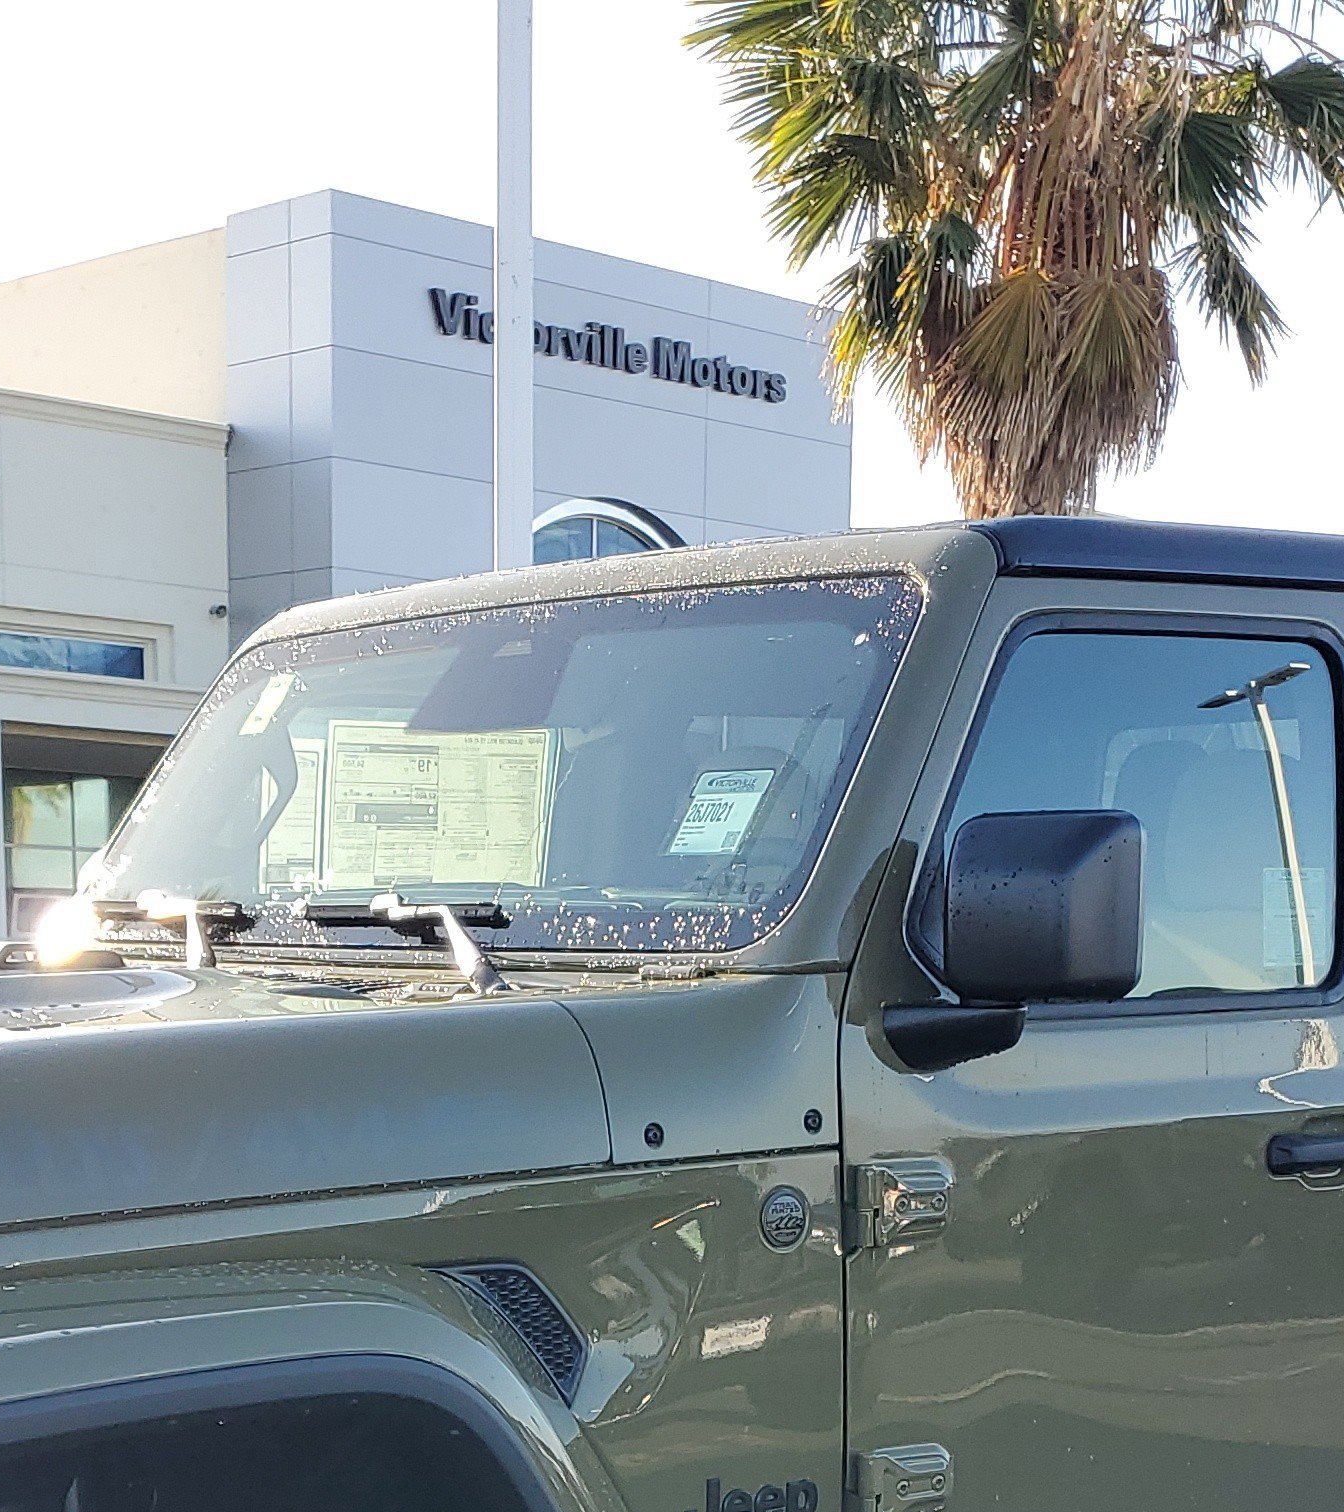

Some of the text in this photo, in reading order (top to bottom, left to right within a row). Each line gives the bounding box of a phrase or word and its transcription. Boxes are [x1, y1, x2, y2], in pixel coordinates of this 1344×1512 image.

[428, 287, 787, 403] Vicorville Motors
[685, 801, 735, 823] 26J7021
